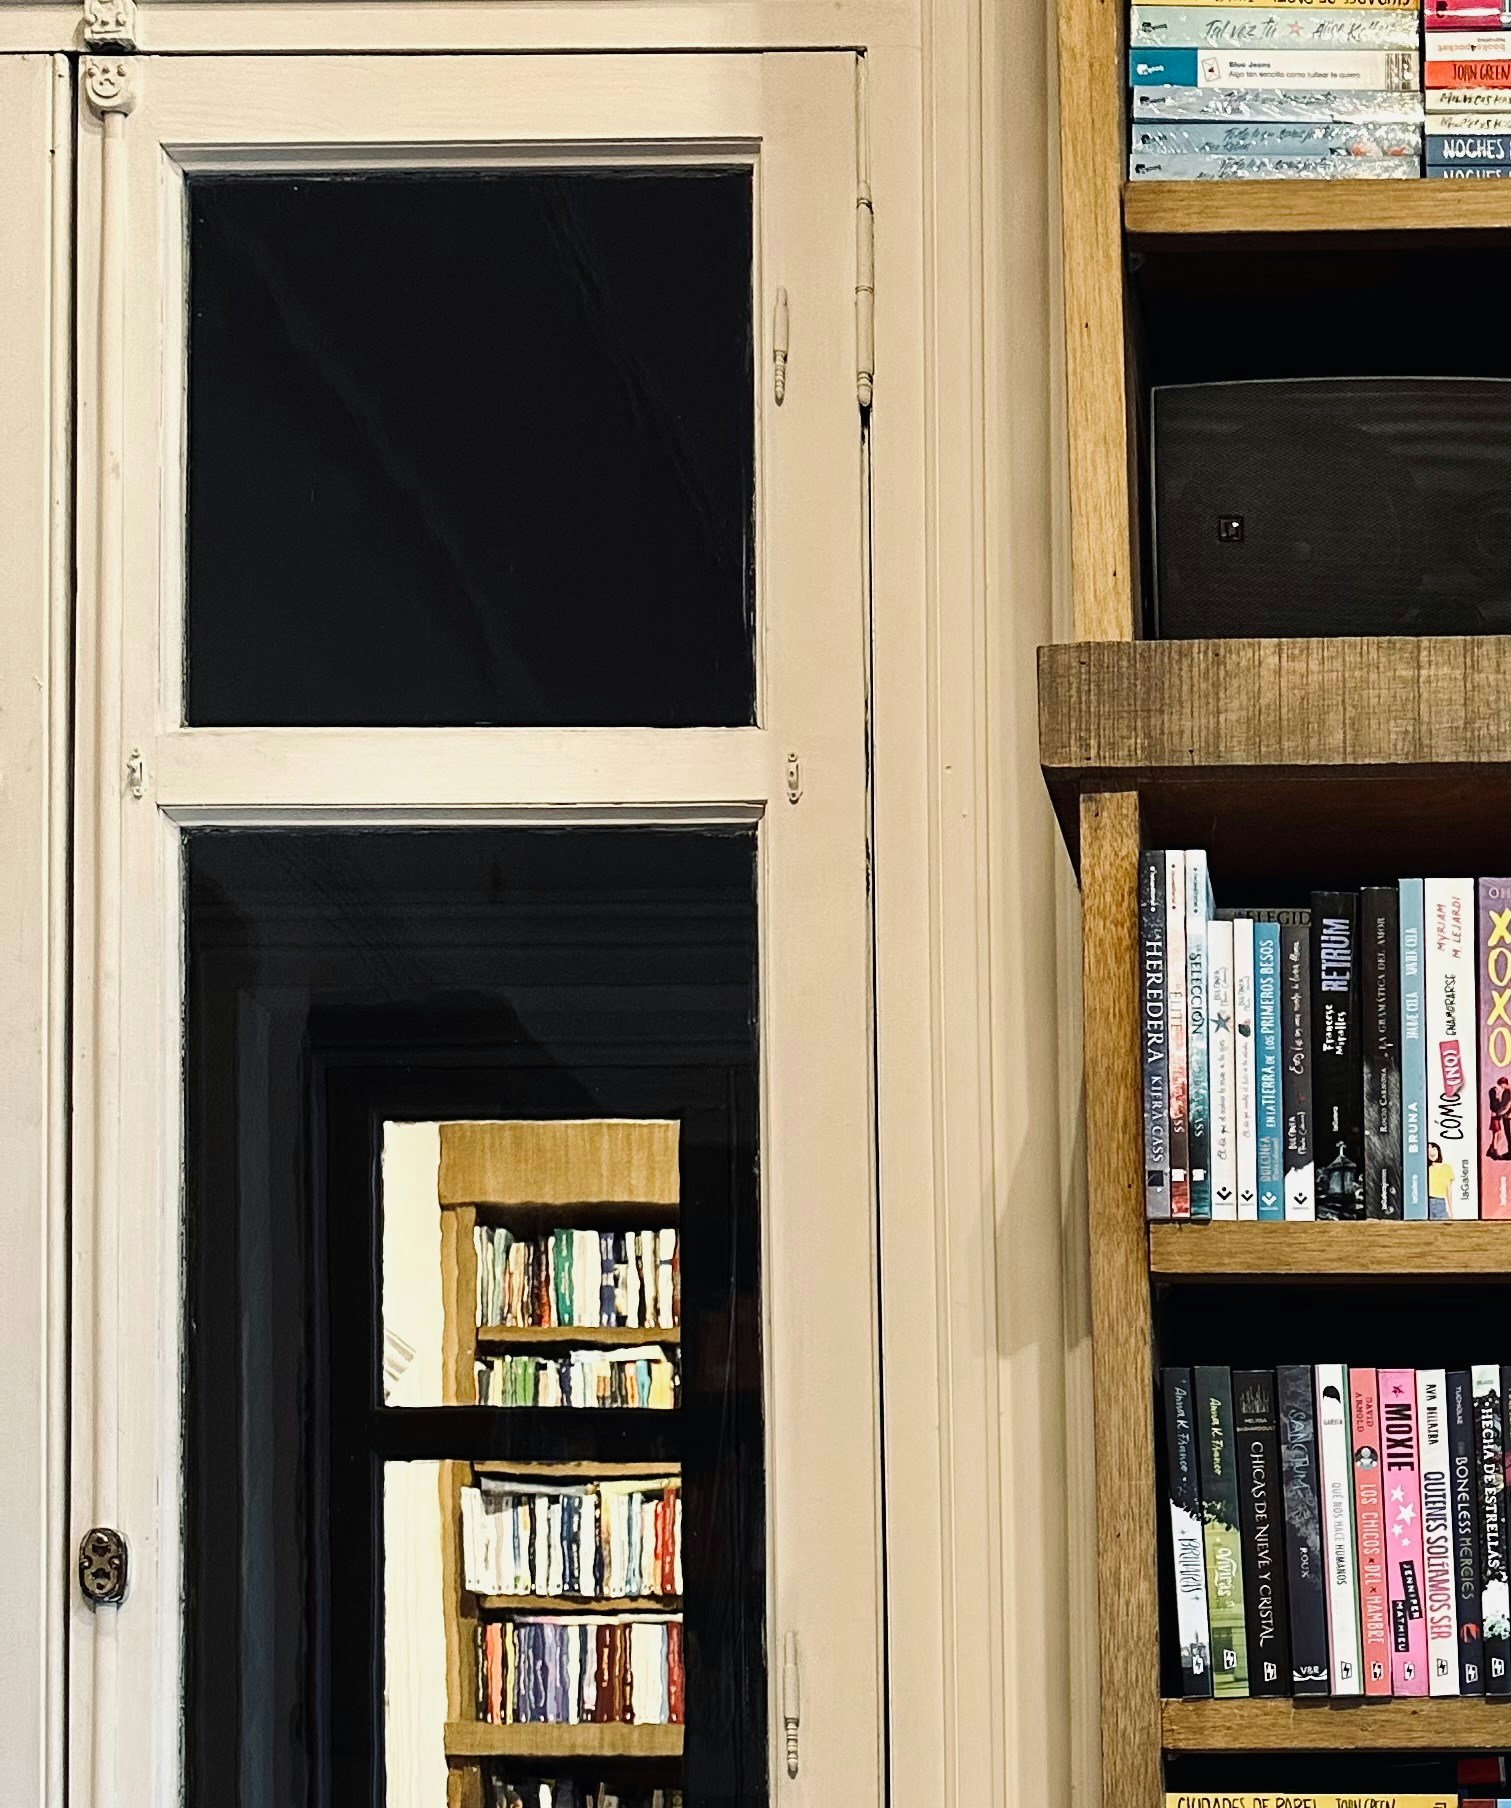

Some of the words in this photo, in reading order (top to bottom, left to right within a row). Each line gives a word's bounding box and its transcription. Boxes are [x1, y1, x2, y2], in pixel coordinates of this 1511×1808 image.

[1452, 63, 1479, 82] JOHN
[1479, 62, 1511, 81] GREEN
[1322, 917, 1351, 994] RETRUM
[1146, 940, 1163, 1064] HEREDERA
[1151, 1075, 1162, 1122] KIERA
[1152, 1127, 1163, 1163] CASS
[1385, 1403, 1416, 1472] MOXIE
